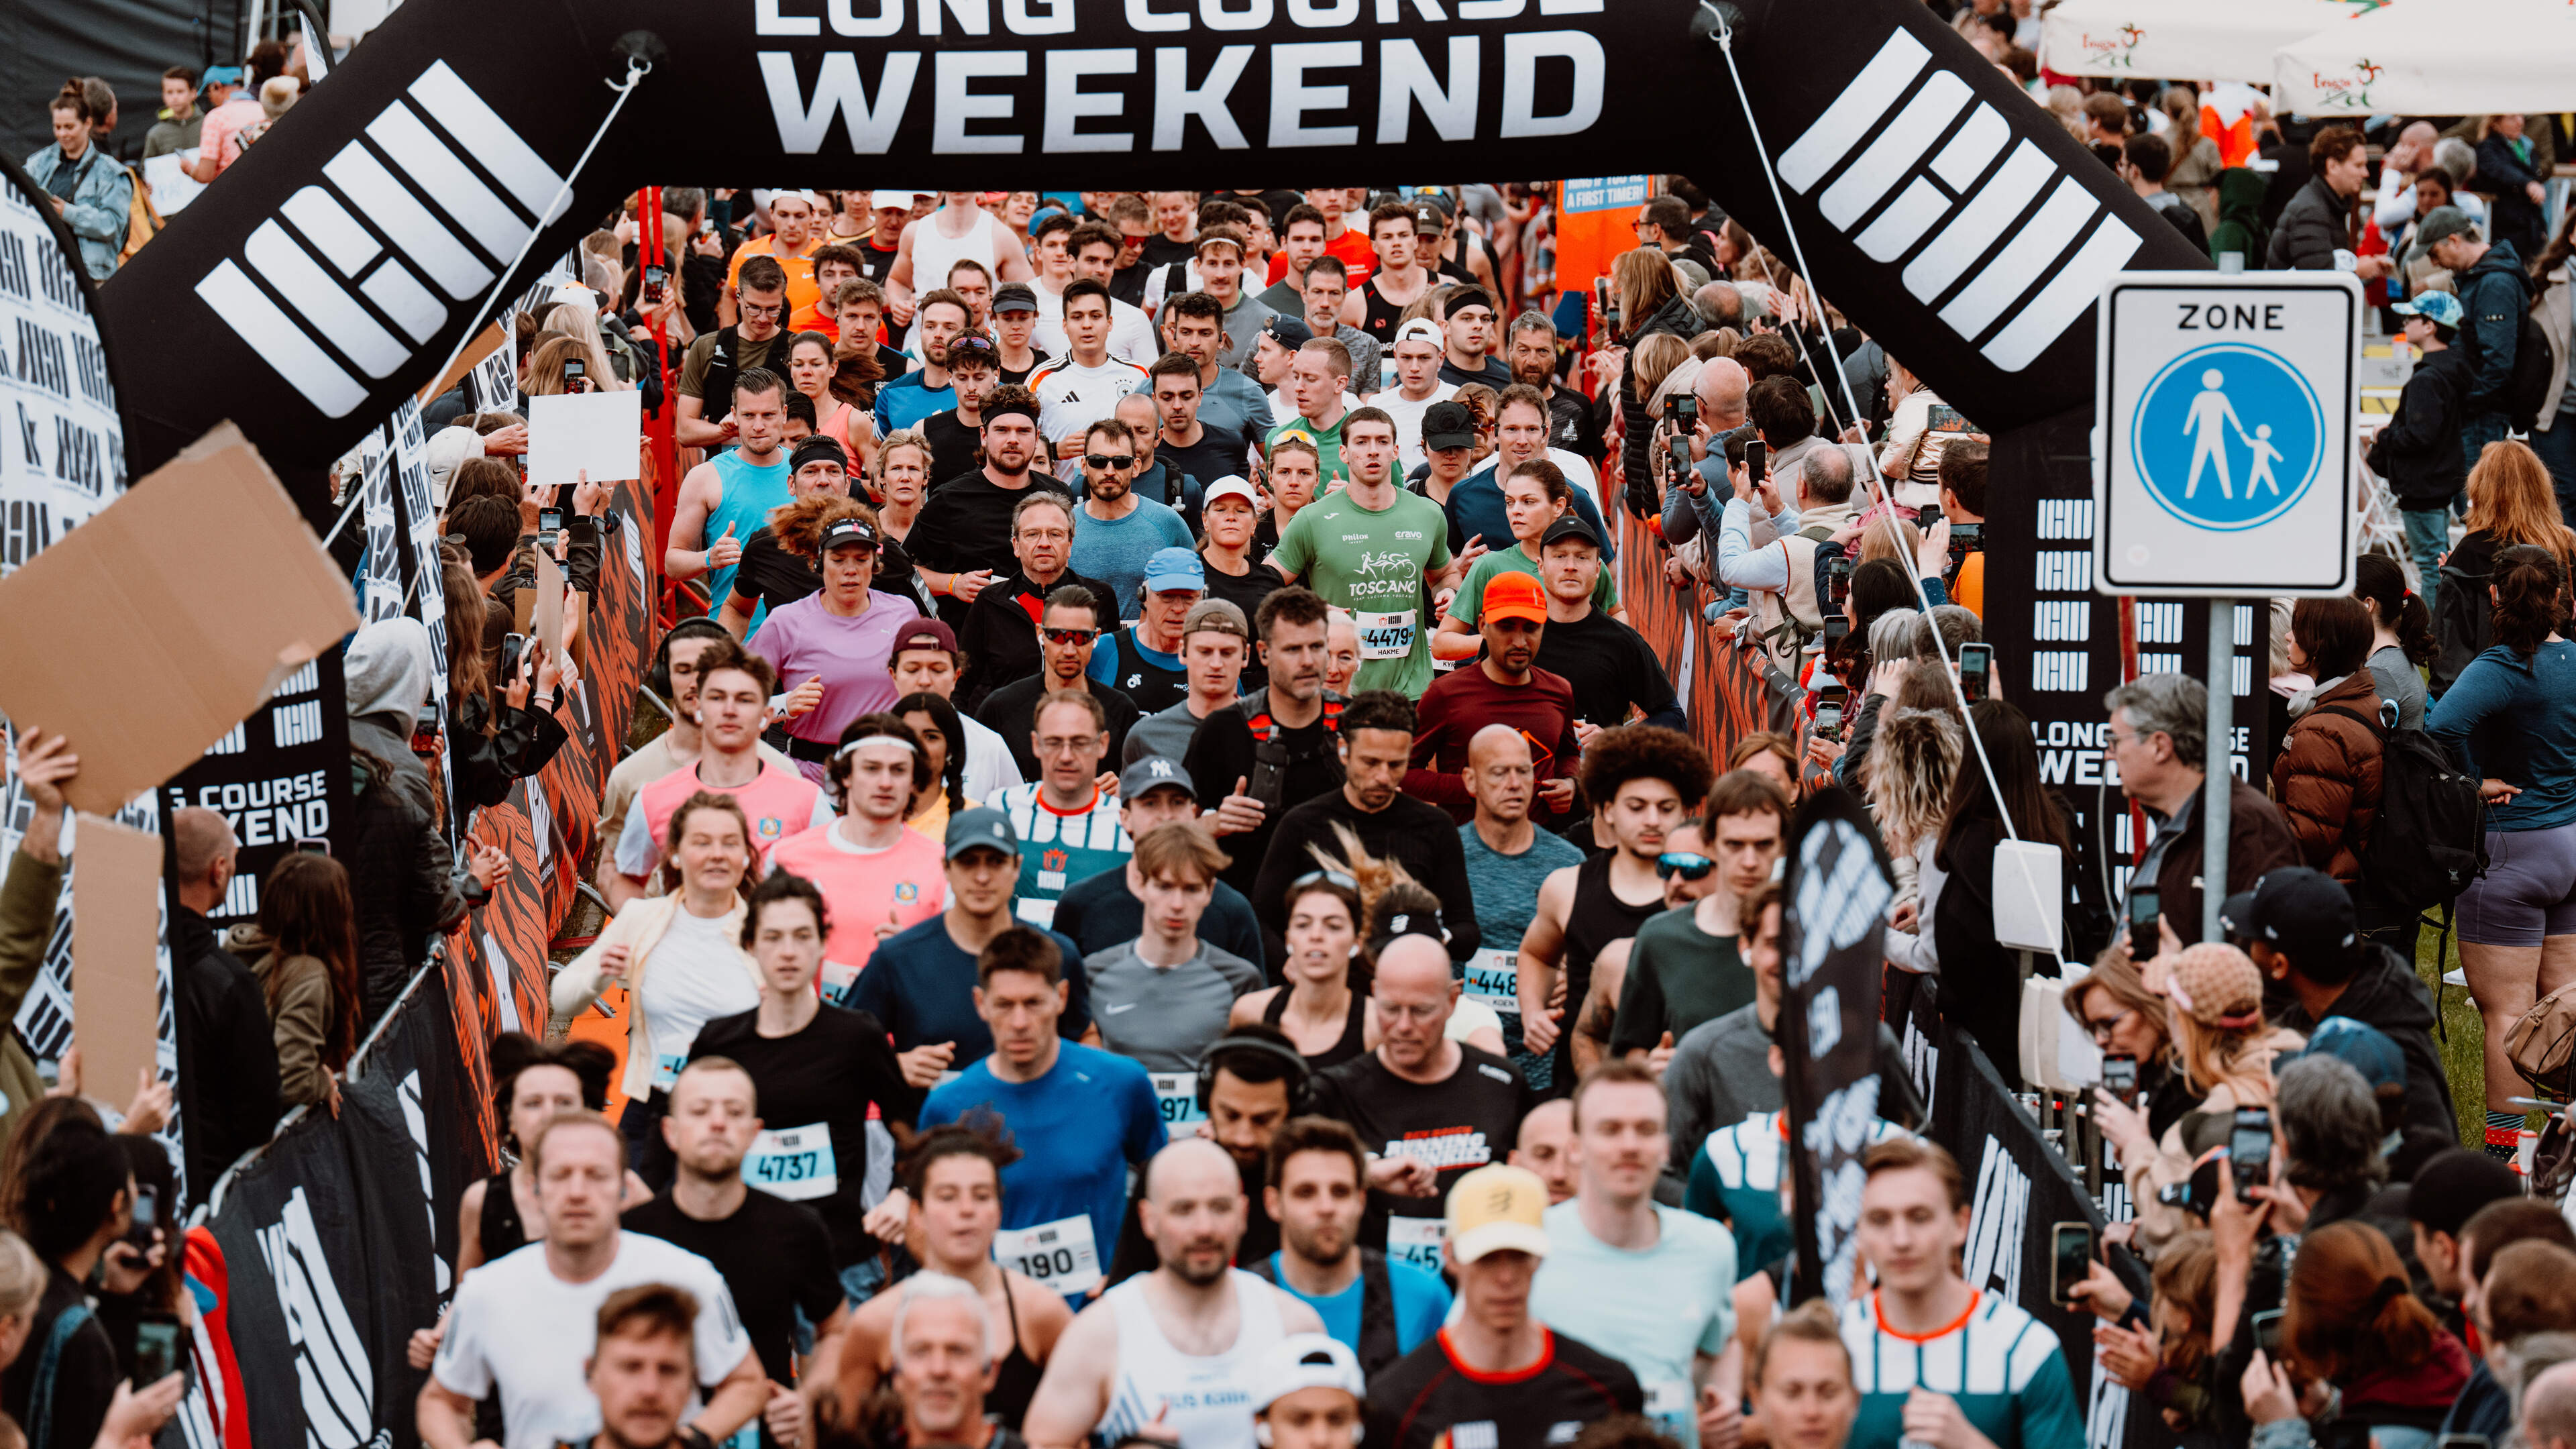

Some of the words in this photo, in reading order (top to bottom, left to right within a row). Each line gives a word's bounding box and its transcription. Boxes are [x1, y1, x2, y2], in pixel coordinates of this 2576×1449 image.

[757, 30, 1605, 154] WEEKEND
[1566, 193, 1574, 209] A
[1576, 189, 1605, 207] FIRST
[1607, 184, 1644, 204] TIMER!
[2178, 305, 2284, 329] ZONE
[1349, 580, 1416, 596] TOSCANO
[1367, 628, 1409, 647] 4479
[199, 770, 327, 812] COURSE
[1478, 970, 1517, 996] 448
[1161, 1097, 1190, 1122] 97
[757, 1152, 817, 1181] 4737
[1017, 1248, 1073, 1279] 190
[1407, 1245, 1438, 1271] 45
